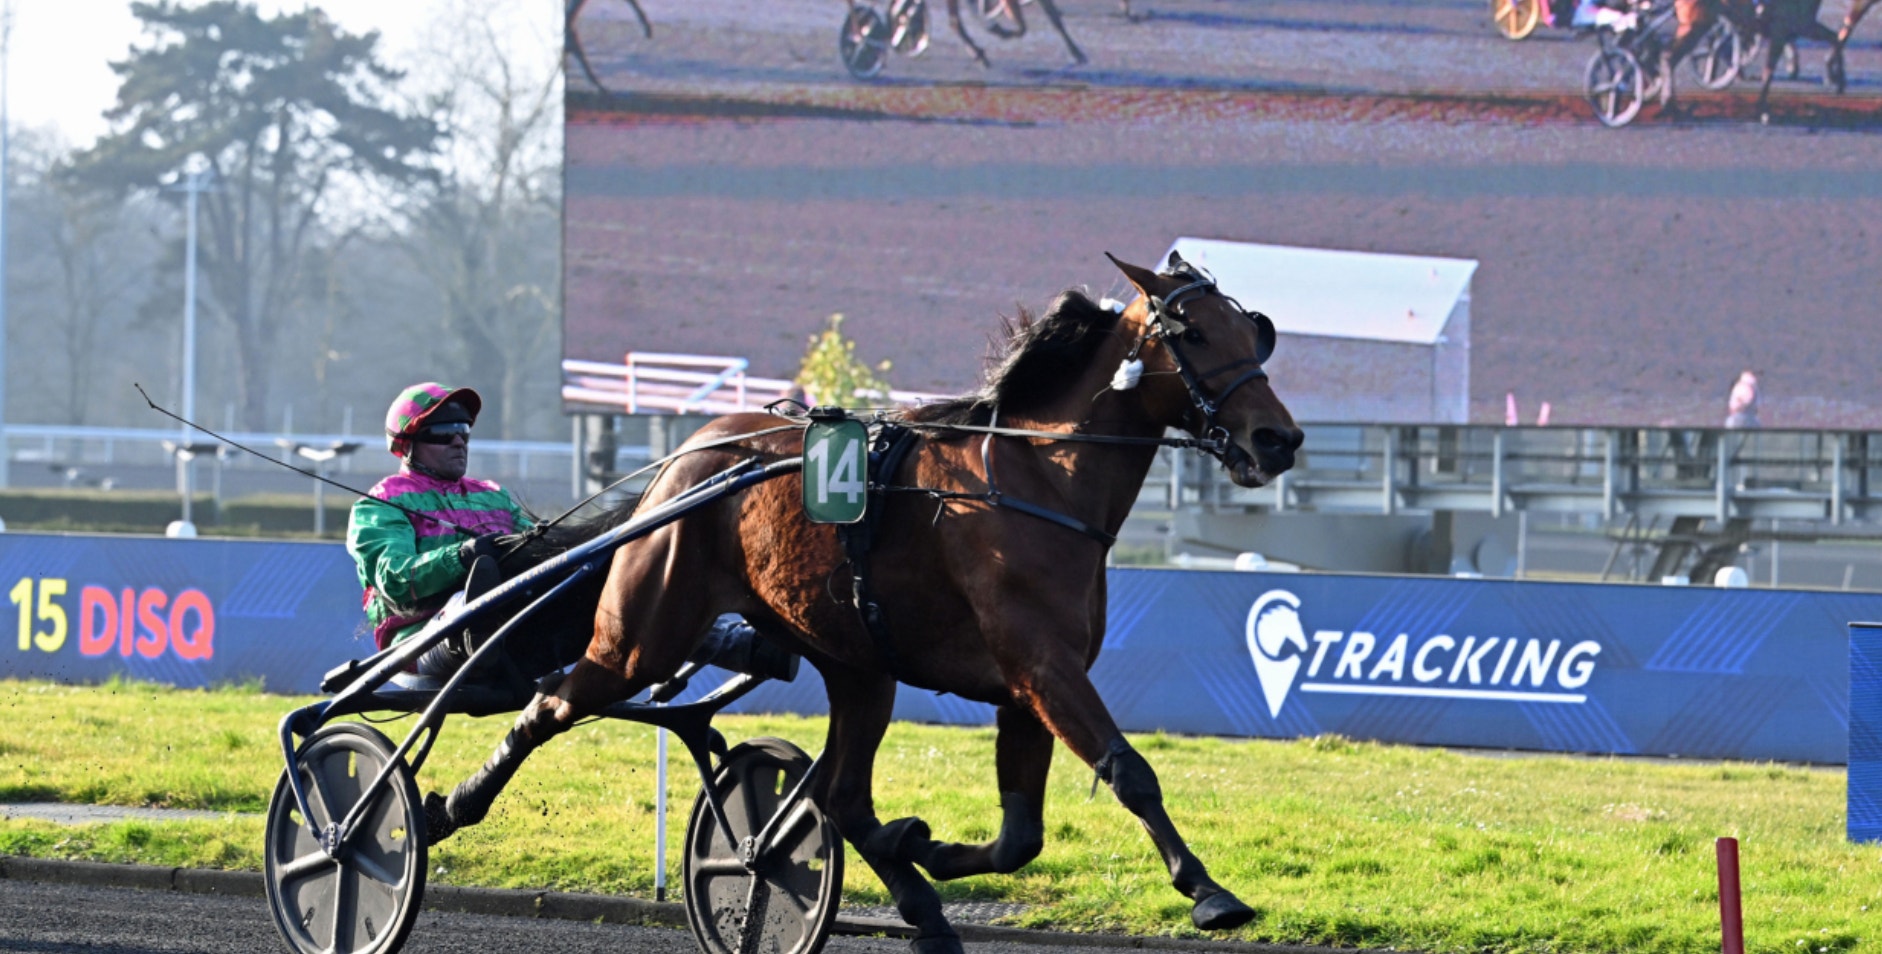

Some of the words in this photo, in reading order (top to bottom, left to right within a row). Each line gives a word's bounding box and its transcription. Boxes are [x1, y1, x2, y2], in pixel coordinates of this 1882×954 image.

[807, 438, 863, 503] 14
[9, 577, 67, 652] 15
[79, 586, 215, 660] DISQ
[1306, 630, 1602, 689] TRACKING
